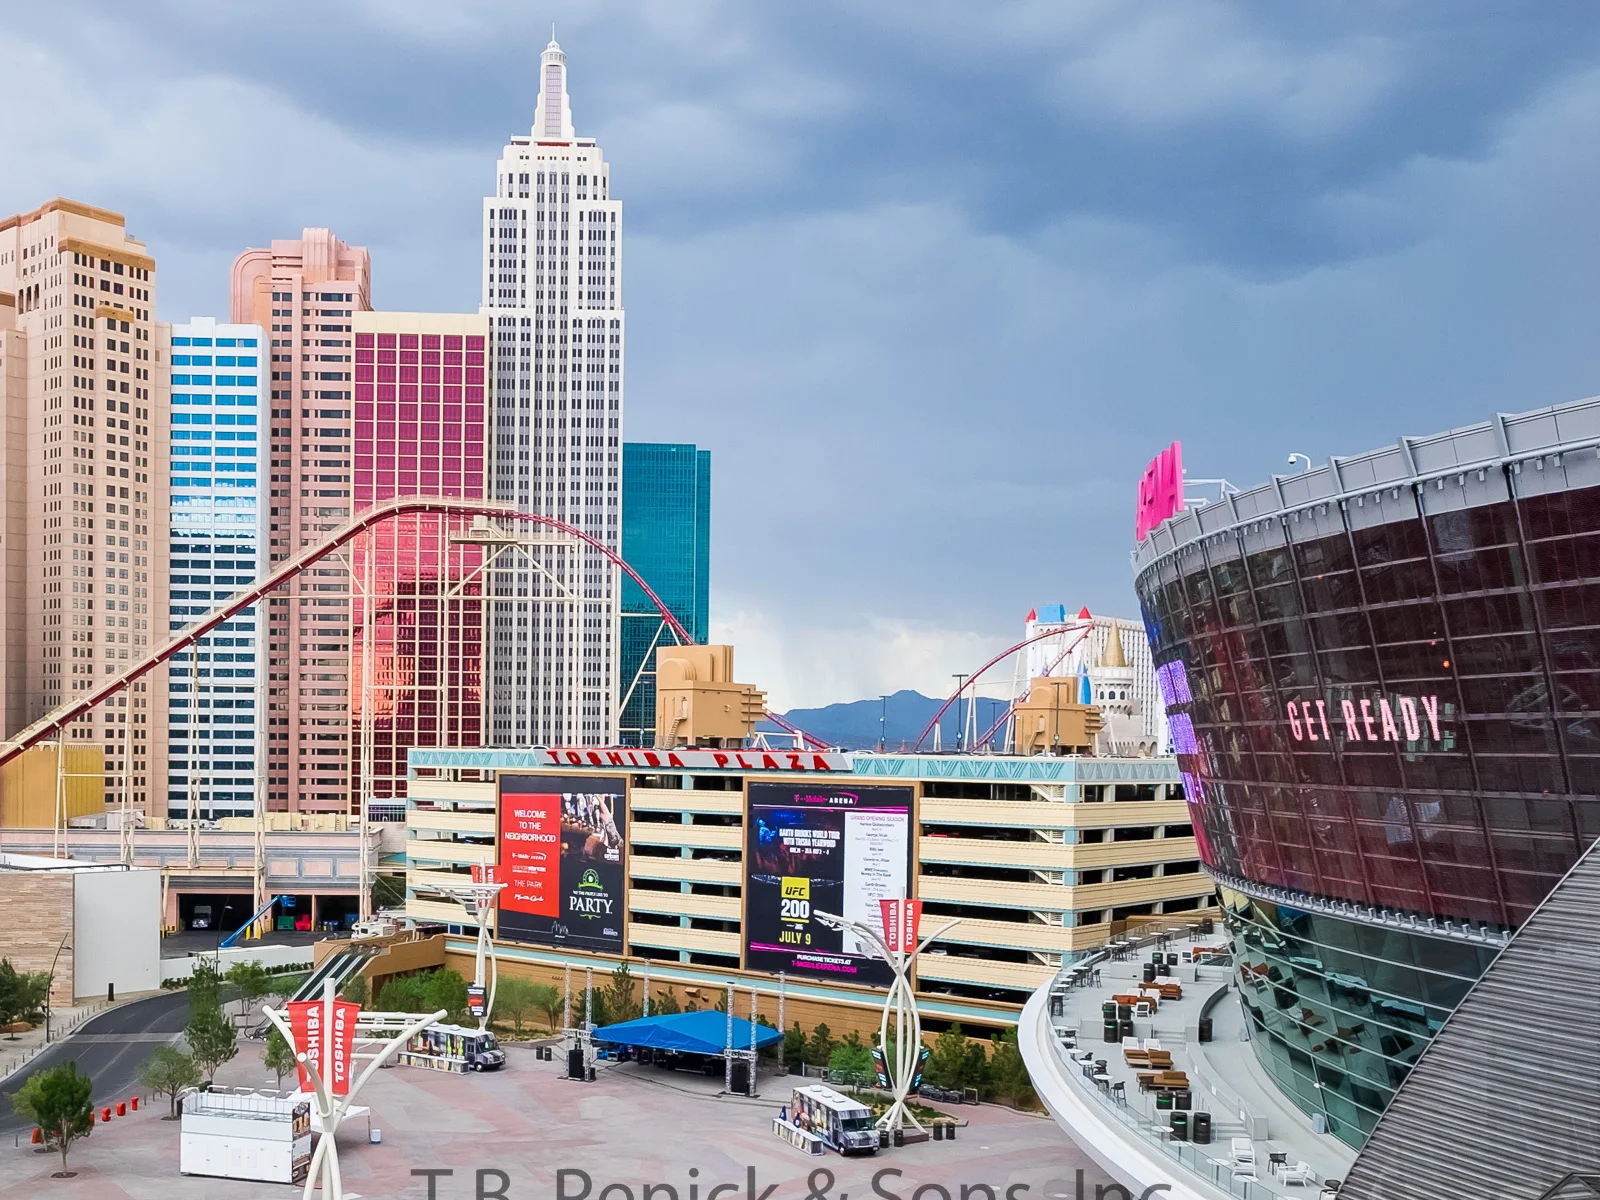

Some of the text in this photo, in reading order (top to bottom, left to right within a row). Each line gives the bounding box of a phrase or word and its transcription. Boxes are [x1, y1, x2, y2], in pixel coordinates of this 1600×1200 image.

[1287, 694, 1440, 742] GET READY
[546, 750, 831, 770] TOSHIBA PLAZA
[514, 810, 547, 819] WELCOME
[528, 822, 542, 831] THE
[504, 832, 556, 843] NEIGHBORHOOD
[514, 880, 543, 889] THE PARK
[785, 886, 806, 896] UFC
[781, 899, 810, 919] 200
[889, 902, 897, 946] TOSHIBA
[779, 931, 811, 945] JULY 9
[796, 954, 823, 963] PURCHASE
[824, 956, 843, 965] TICKETS
[335, 1008, 346, 1083] TOSHIBA
